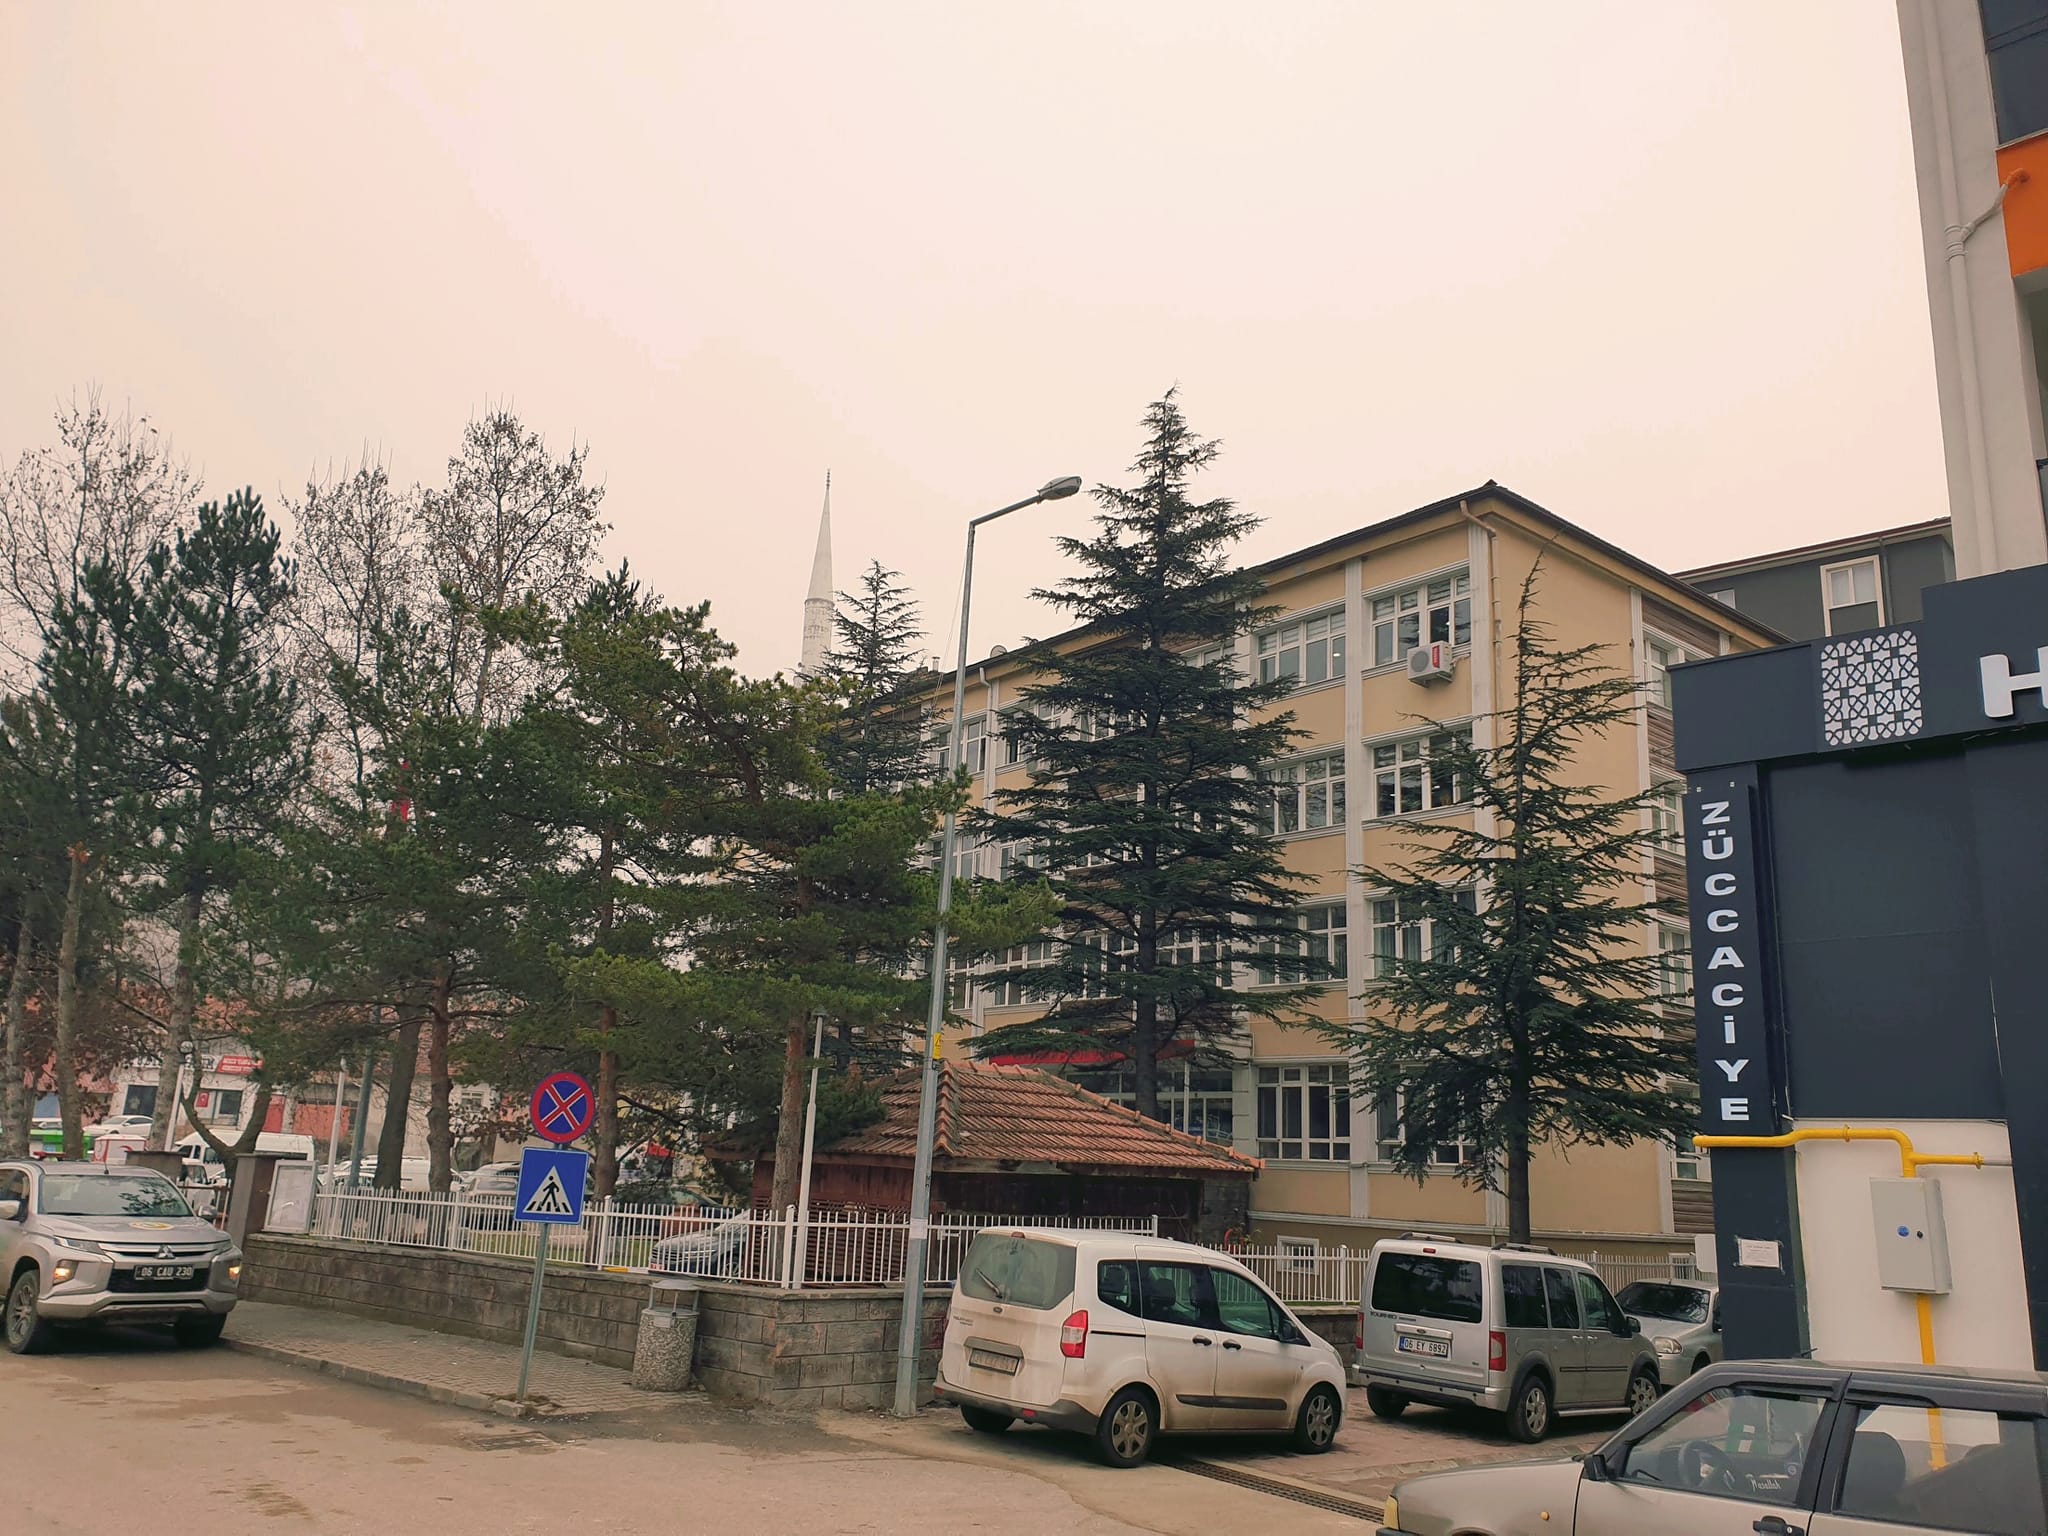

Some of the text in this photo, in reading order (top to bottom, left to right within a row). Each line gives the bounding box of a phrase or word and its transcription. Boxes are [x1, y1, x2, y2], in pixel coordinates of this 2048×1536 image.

[1701, 801, 1750, 1121] ZÜCCACİYE
[1404, 1339, 1413, 1349] 06
[1416, 1341, 1425, 1351] EY
[1428, 1343, 1446, 1354] 6892
